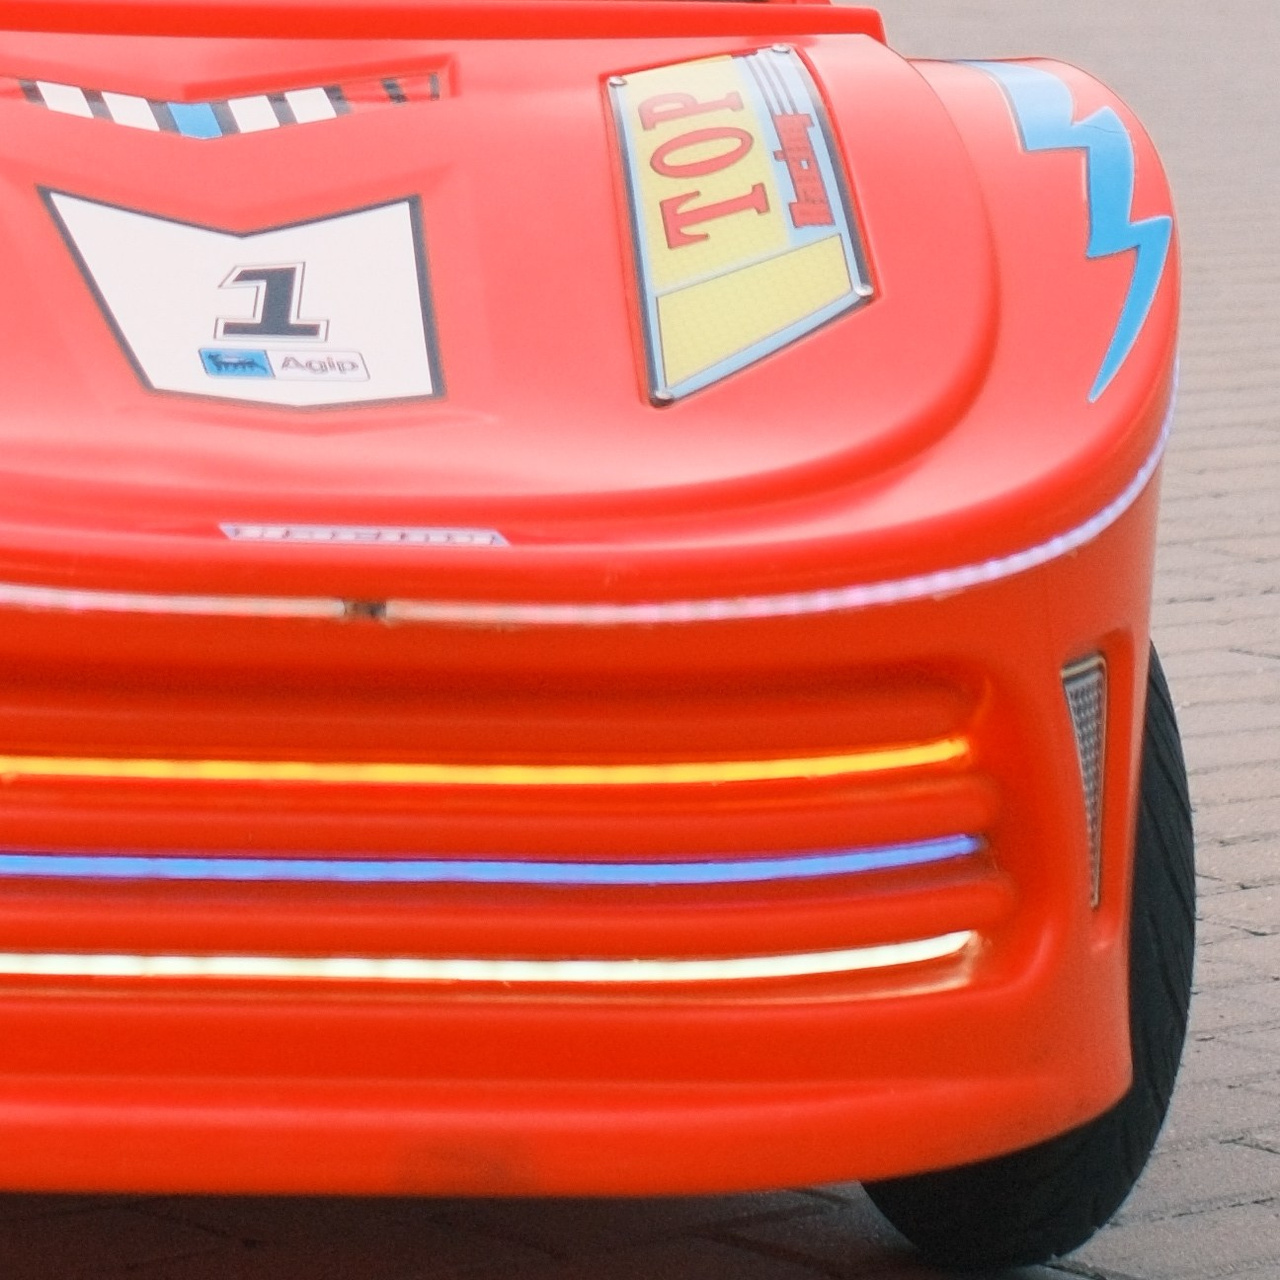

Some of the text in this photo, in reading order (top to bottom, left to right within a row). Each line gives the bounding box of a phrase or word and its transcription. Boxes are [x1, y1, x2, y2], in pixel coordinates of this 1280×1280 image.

[636, 90, 771, 250] TOP
[214, 261, 330, 342] 1
[280, 355, 360, 375] Agip
